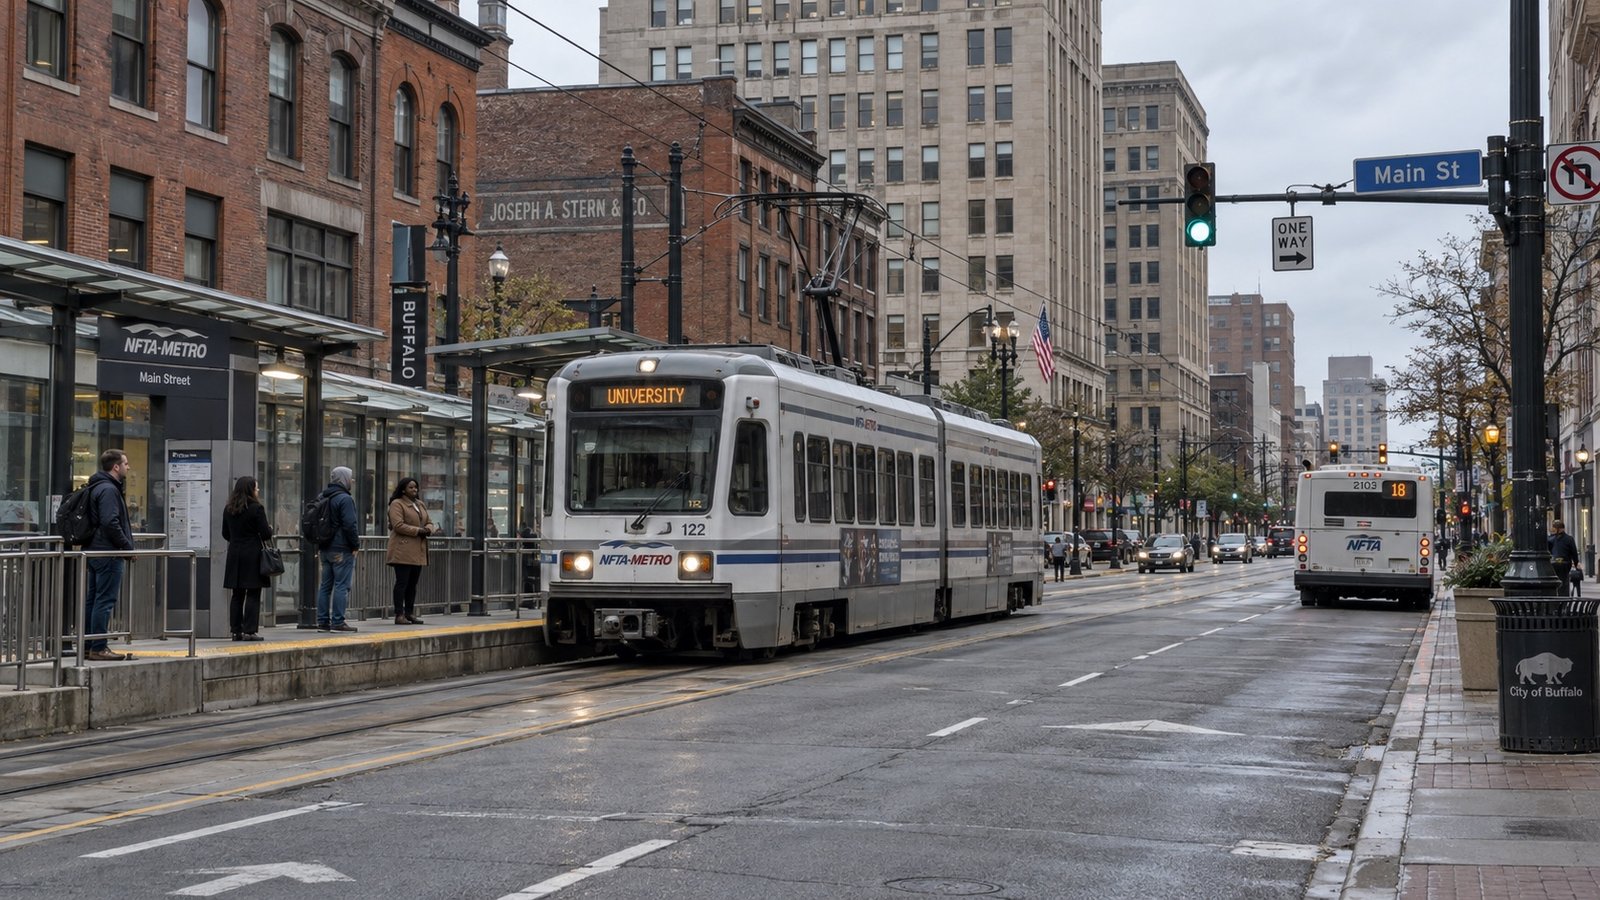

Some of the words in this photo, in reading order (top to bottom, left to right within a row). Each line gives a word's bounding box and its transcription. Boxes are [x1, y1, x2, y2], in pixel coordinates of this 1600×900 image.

[1375, 165, 1425, 185] Main
[1436, 161, 1460, 180] St
[490, 201, 540, 222] JOSEPH
[544, 200, 558, 220] A.
[562, 199, 606, 219] STERN
[611, 198, 621, 217] &
[1278, 222, 1307, 234] ONE
[1278, 236, 1308, 249] WAY
[402, 300, 416, 379] BUFFALO
[124, 337, 208, 359] NFTA-METRO
[139, 371, 161, 385] Main
[163, 372, 191, 386] Street
[608, 388, 684, 404] UNIVERSITY
[1353, 481, 1377, 490] 2103
[1391, 483, 1406, 497] 18
[682, 523, 706, 536] 122
[1346, 540, 1381, 551] NFTA
[599, 554, 673, 566] NFTA-METRO
[1510, 686, 1528, 699] City
[1531, 686, 1543, 697] of
[1545, 686, 1583, 697] Buffalo
